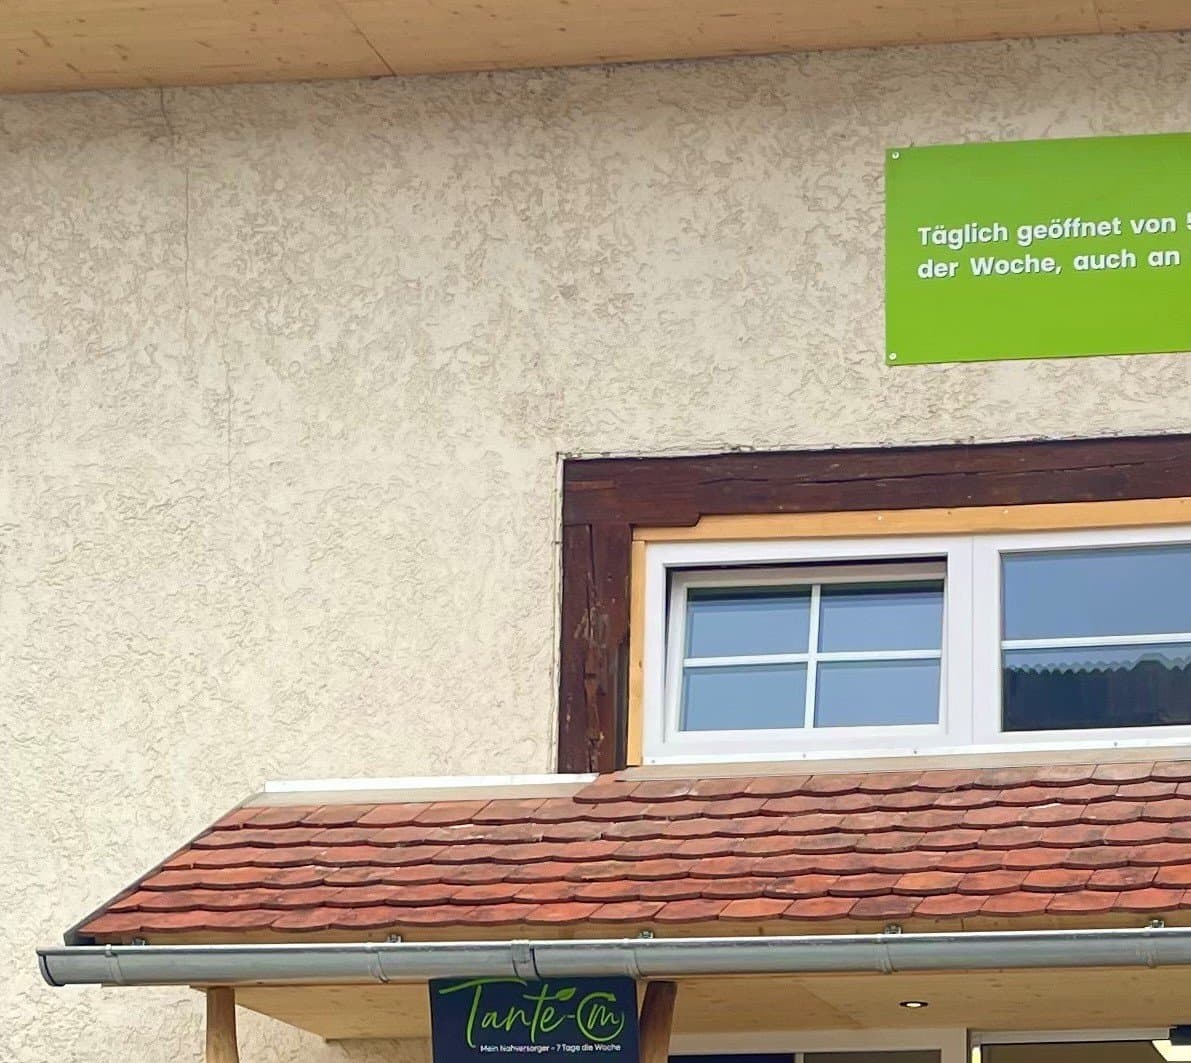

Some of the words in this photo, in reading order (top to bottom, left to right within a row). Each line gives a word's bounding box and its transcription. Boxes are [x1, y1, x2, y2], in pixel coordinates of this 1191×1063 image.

[918, 222, 1008, 250] Täglich
[1016, 217, 1122, 246] geöffnet
[1130, 215, 1176, 235] von
[918, 259, 959, 282] der
[970, 254, 1062, 276] Woche,
[1073, 249, 1137, 272] auch
[1148, 249, 1181, 268] an
[480, 1044, 499, 1053] Mein
[500, 1044, 550, 1054] Nahversorger
[562, 1044, 581, 1053] Tage
[582, 1043, 594, 1052] die
[595, 1043, 621, 1052] Woche
